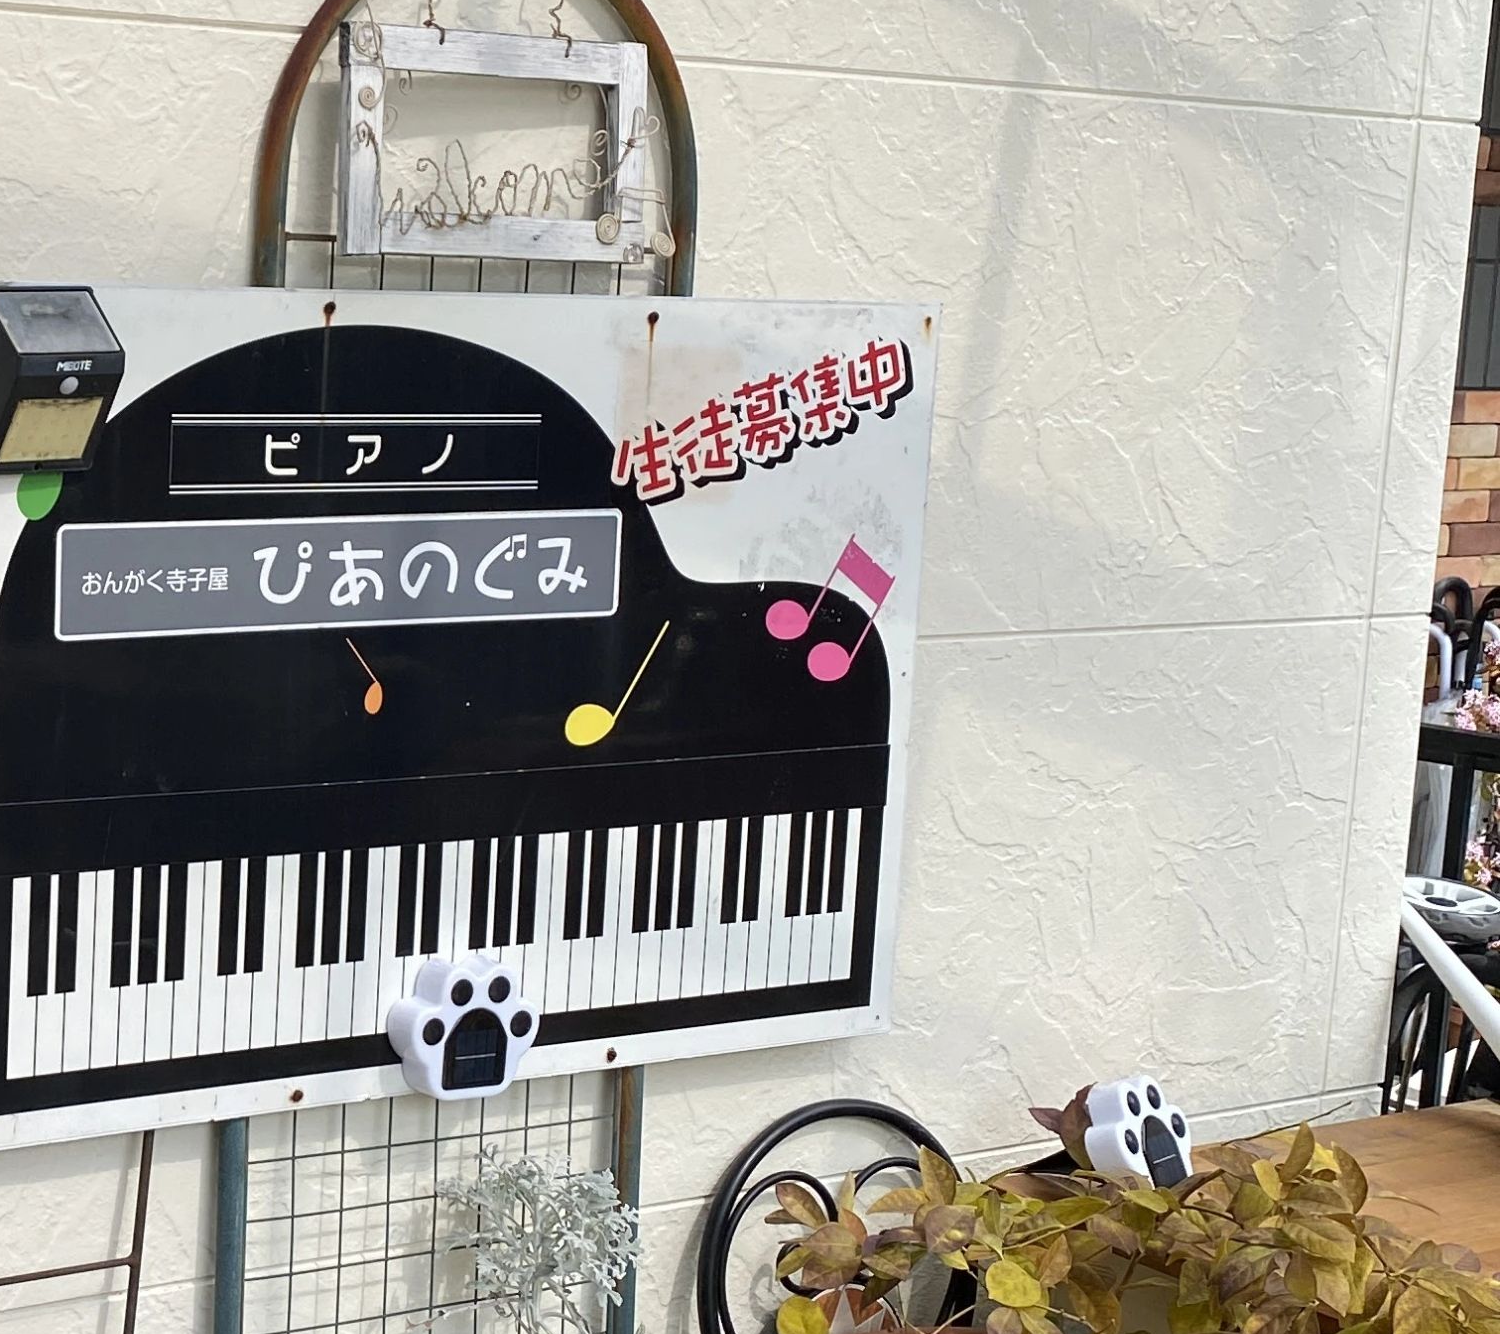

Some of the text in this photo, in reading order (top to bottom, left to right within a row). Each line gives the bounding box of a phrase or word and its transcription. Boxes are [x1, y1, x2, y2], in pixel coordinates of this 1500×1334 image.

[264, 433, 454, 476] ピアノ
[612, 338, 912, 503] 生徒募集中
[80, 533, 589, 607] おんがく寺子屋 ぴあのぐみ
